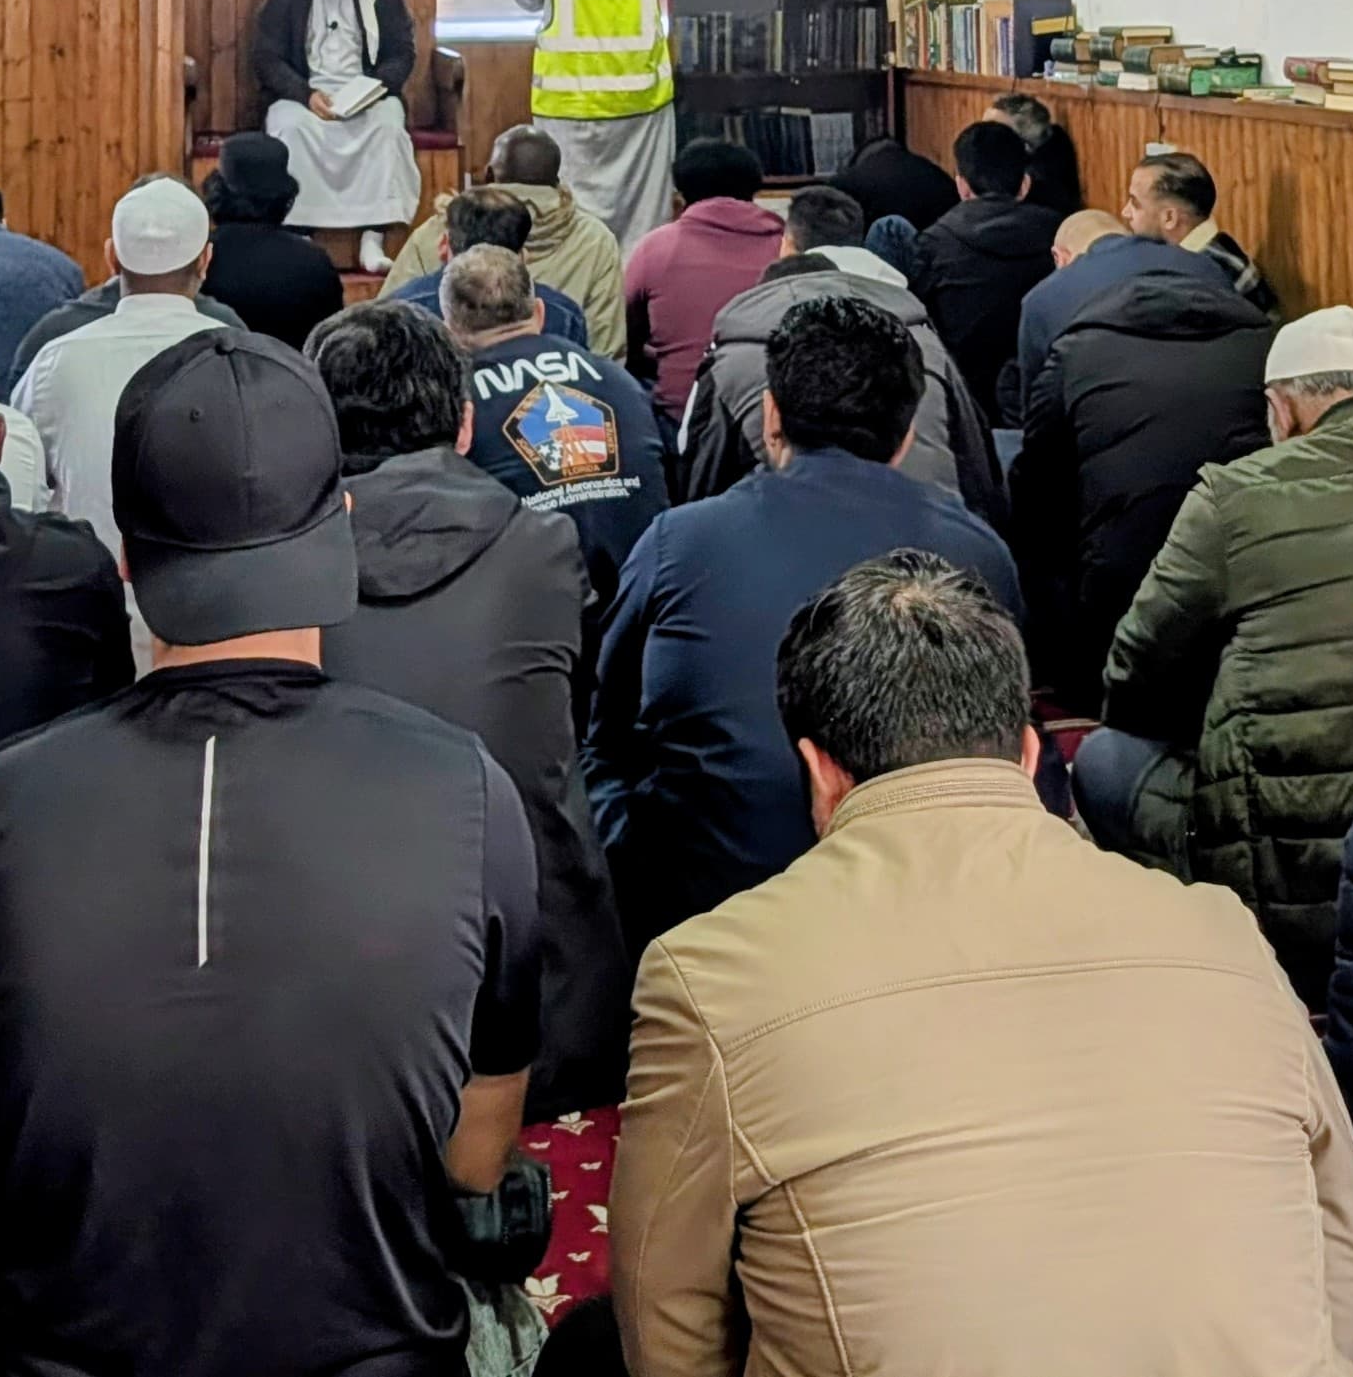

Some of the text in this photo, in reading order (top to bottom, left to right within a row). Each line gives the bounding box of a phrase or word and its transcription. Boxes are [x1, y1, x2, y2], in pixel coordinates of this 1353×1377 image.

[474, 351, 603, 400] NASA
[561, 464, 601, 477] FLORIDA
[521, 475, 641, 508] National Aeronautics and
[559, 487, 631, 507] Administration.
